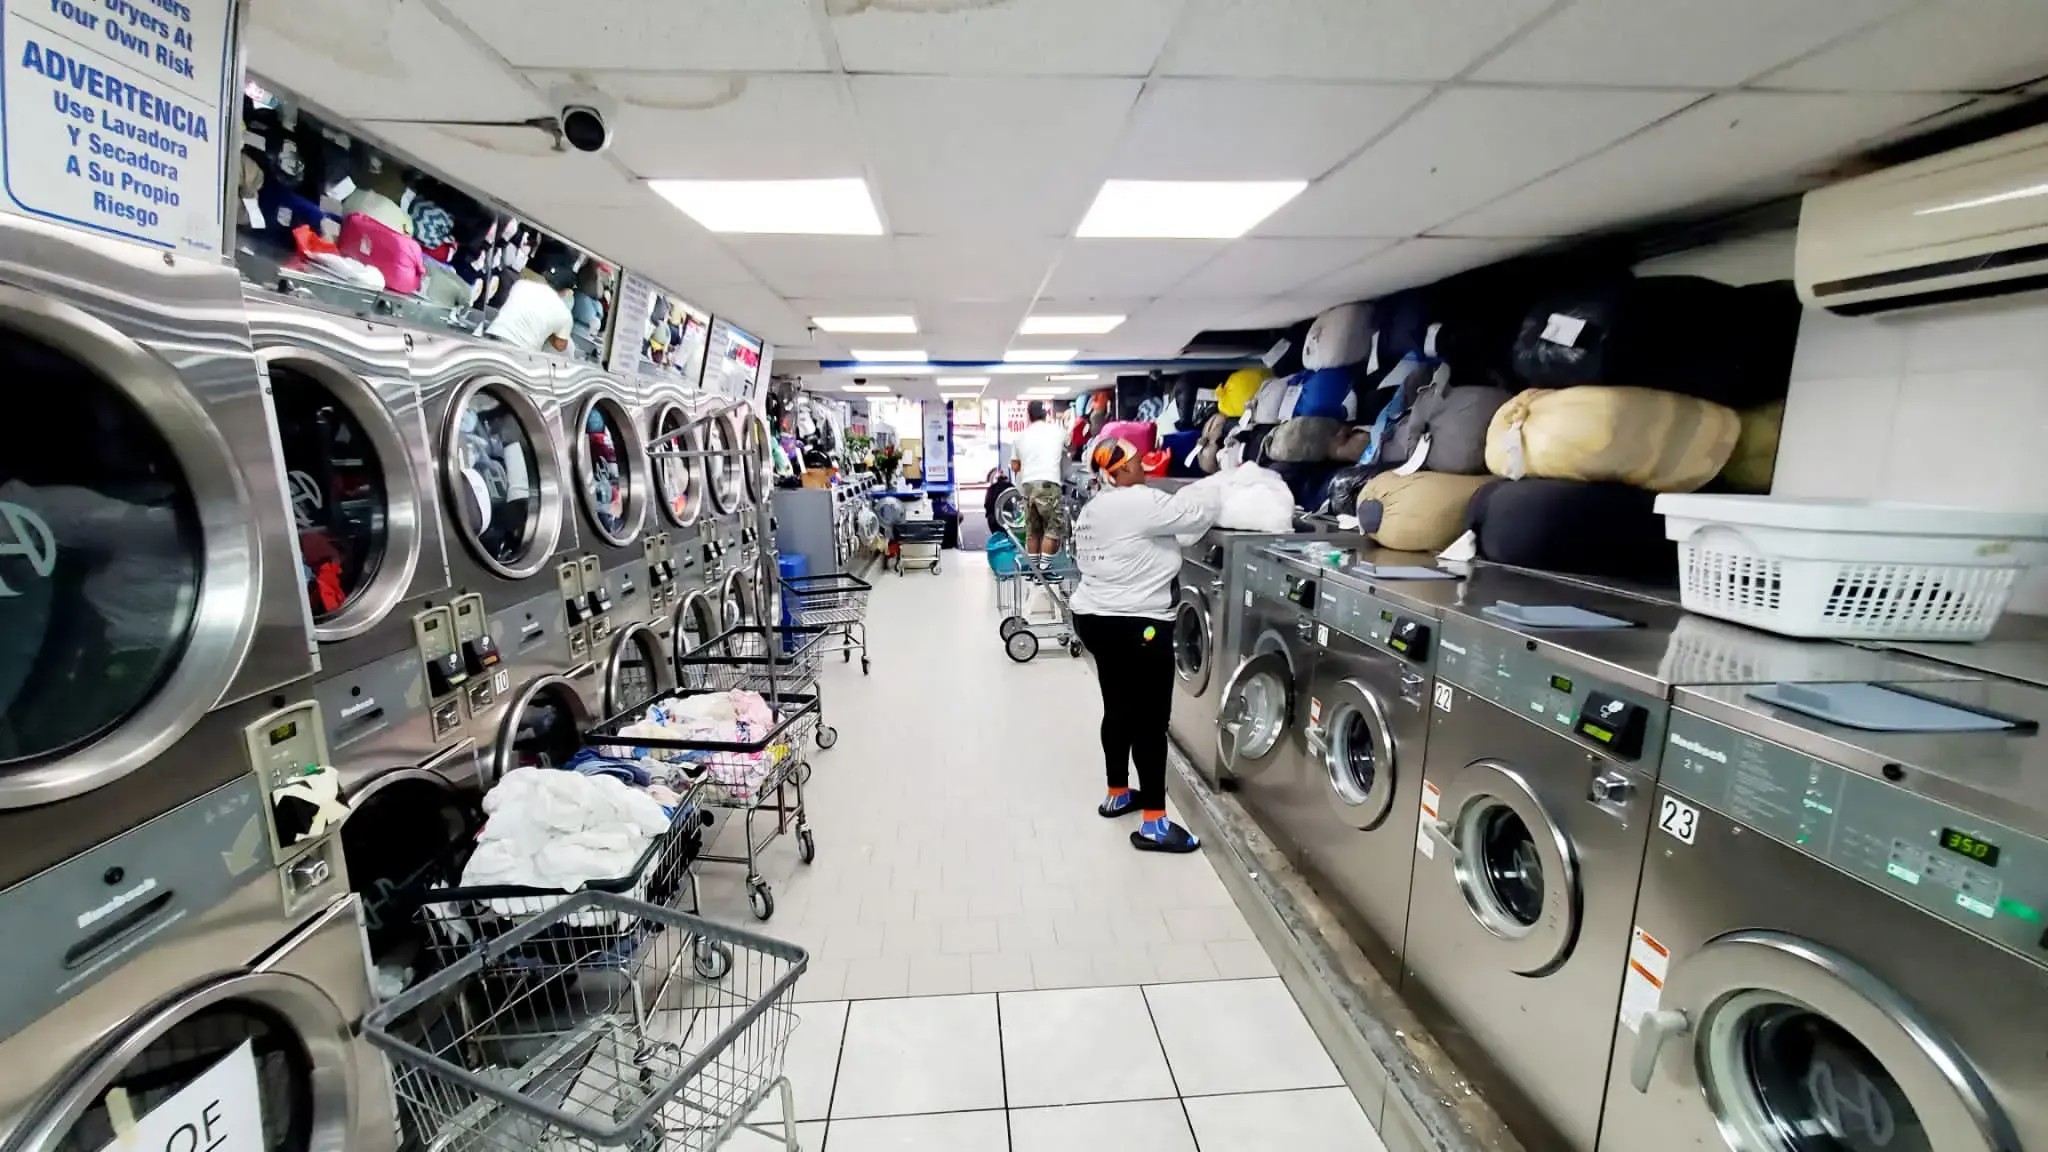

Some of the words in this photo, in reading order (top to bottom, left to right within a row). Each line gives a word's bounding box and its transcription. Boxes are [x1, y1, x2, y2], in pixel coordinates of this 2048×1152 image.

[105, 18, 149, 58] Own
[156, 43, 194, 80] Risk
[173, 27, 193, 52] At
[22, 40, 208, 142] ADVERTENCIA
[53, 90, 95, 124] Use
[102, 110, 188, 159] Lavadora
[67, 124, 81, 147] Y
[88, 132, 178, 182] Secadora
[66, 154, 81, 177] A
[88, 161, 115, 188] Su
[121, 175, 180, 208] Propio
[93, 191, 159, 228] Riesgo
[497, 671, 508, 691] 10
[1436, 685, 1450, 710] 22
[1662, 801, 1694, 840] 23
[1949, 834, 1988, 858] 350
